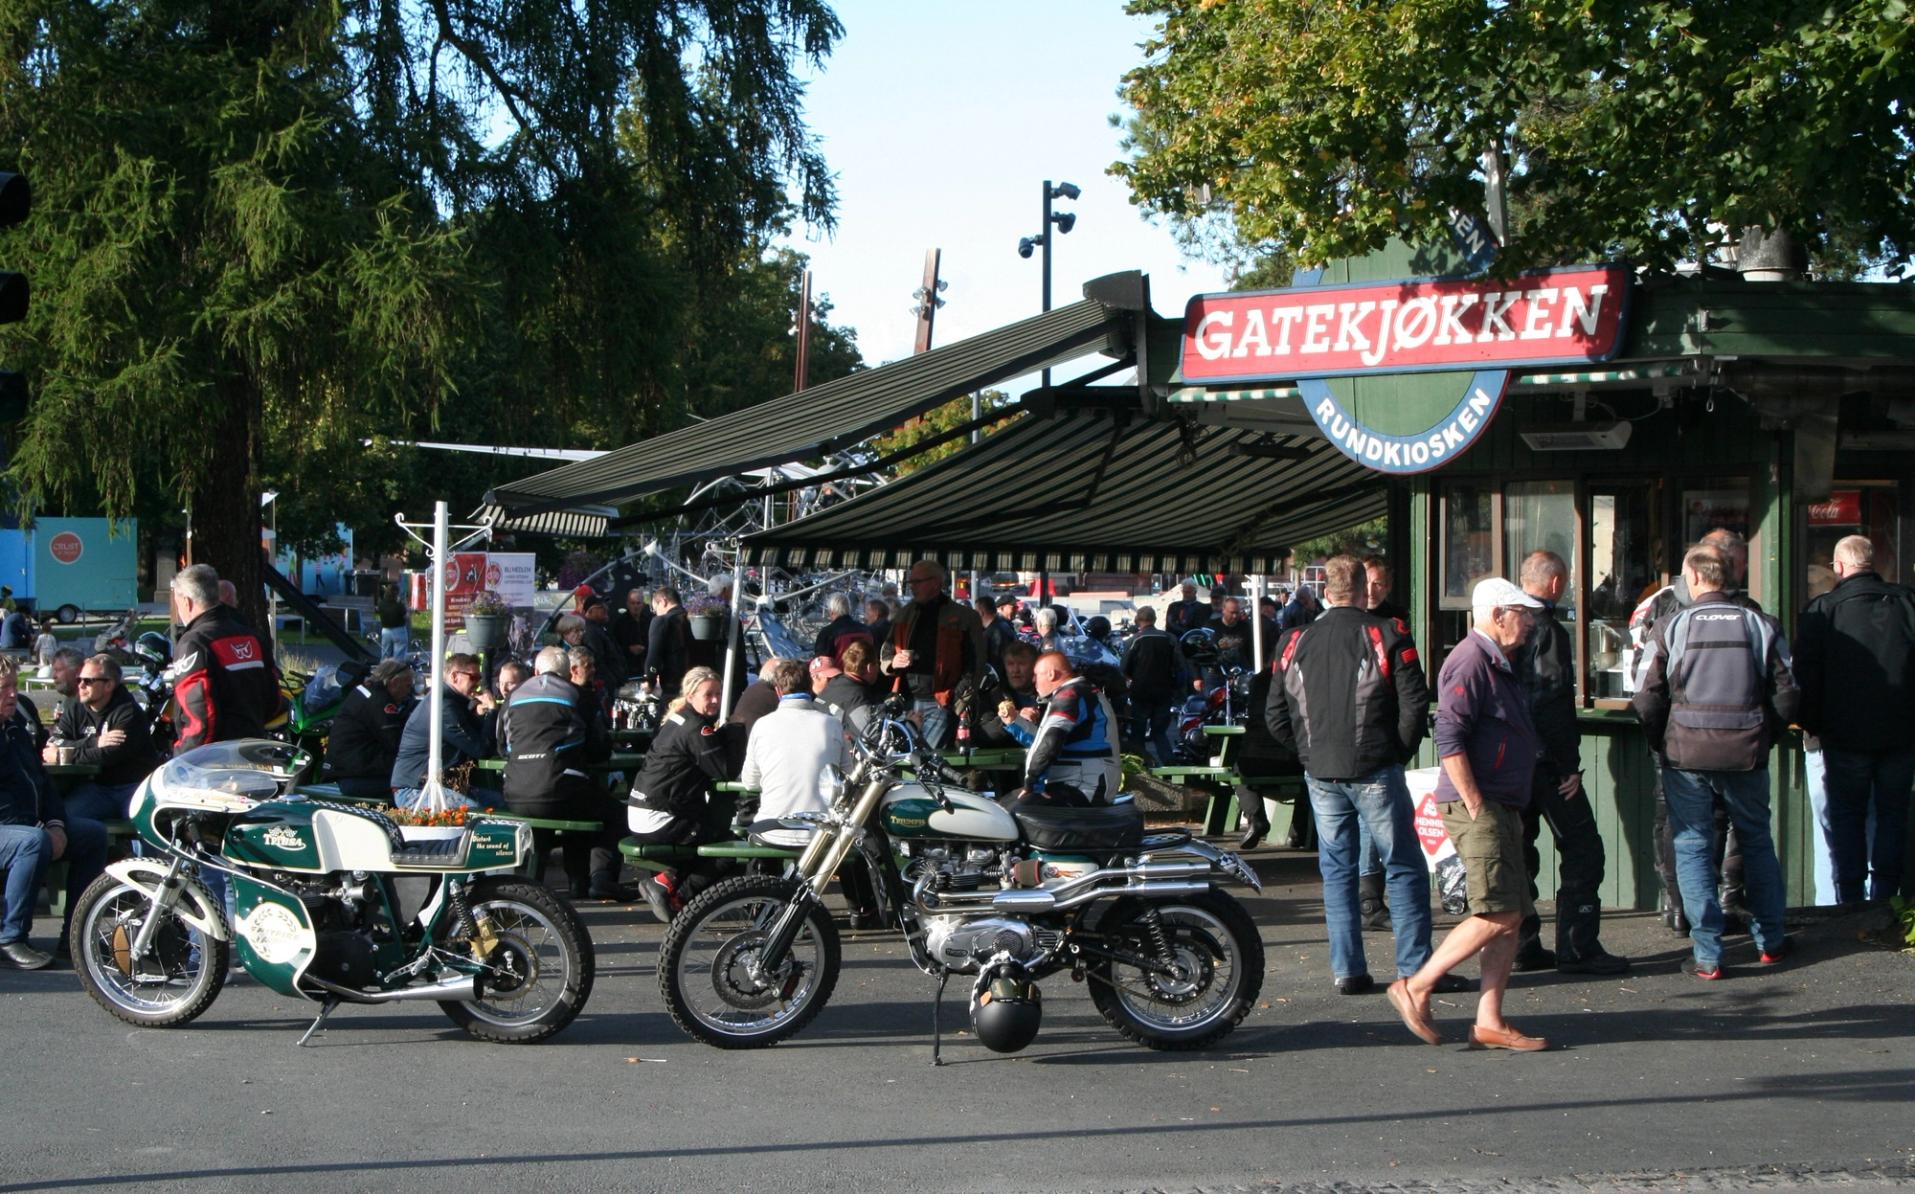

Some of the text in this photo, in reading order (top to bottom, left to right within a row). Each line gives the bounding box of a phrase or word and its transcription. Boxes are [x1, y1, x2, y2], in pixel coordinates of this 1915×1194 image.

[1195, 284, 1609, 366] GATEKJØKKEN
[1316, 388, 1491, 467] RUNDKIOSKEN
[1418, 826, 1444, 838] OLSEN
